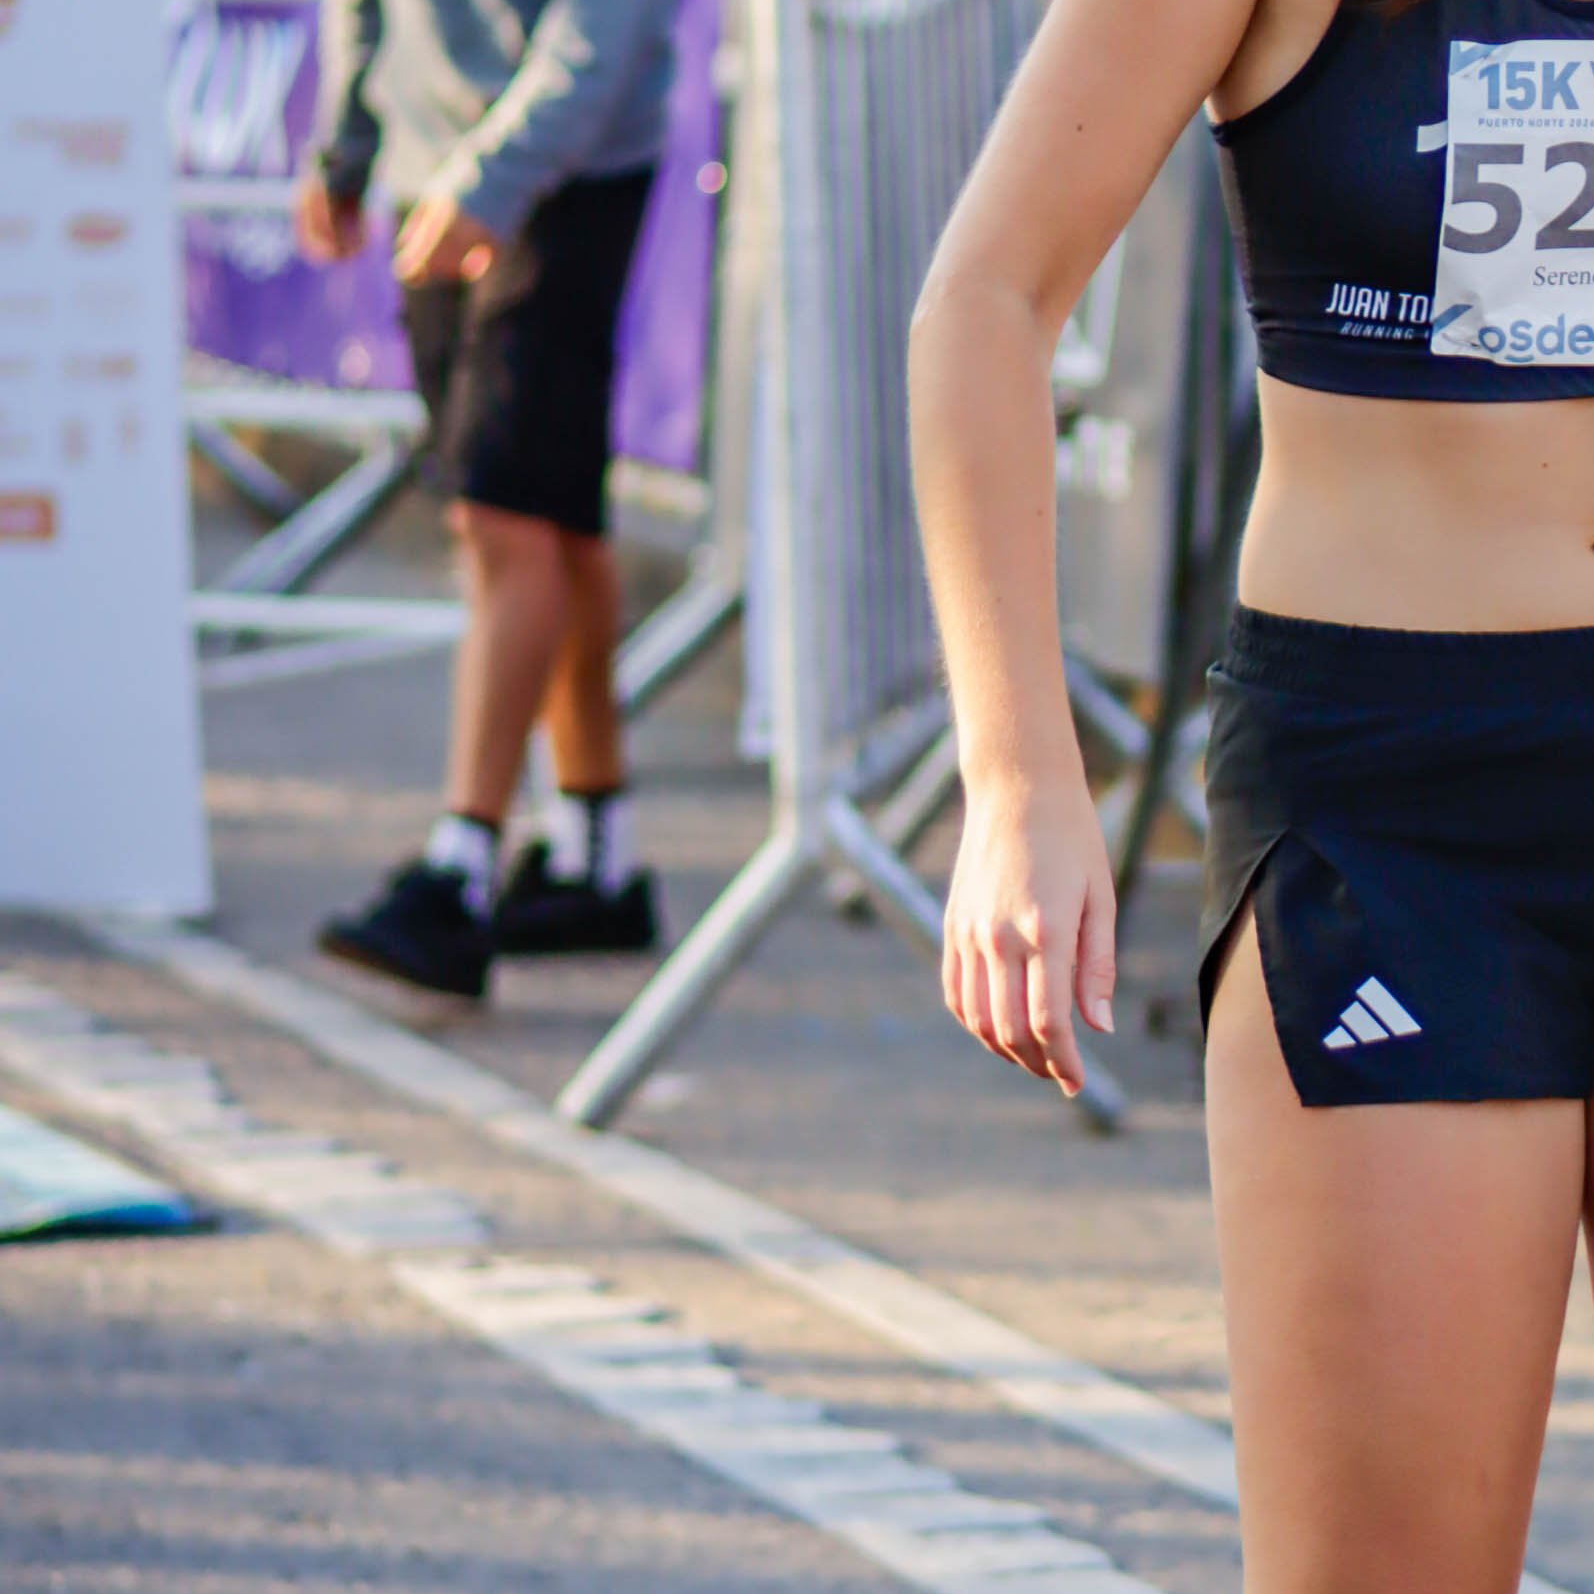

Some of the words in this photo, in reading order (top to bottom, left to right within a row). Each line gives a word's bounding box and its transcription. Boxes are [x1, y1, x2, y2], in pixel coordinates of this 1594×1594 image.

[1478, 61, 1581, 110] 15K
[1478, 118, 1524, 128] PUERTO
[1528, 118, 1564, 128] NORTE
[1325, 283, 1390, 320] JUAN
[1399, 293, 1437, 325] TO
[1340, 322, 1414, 340] RUNNING
